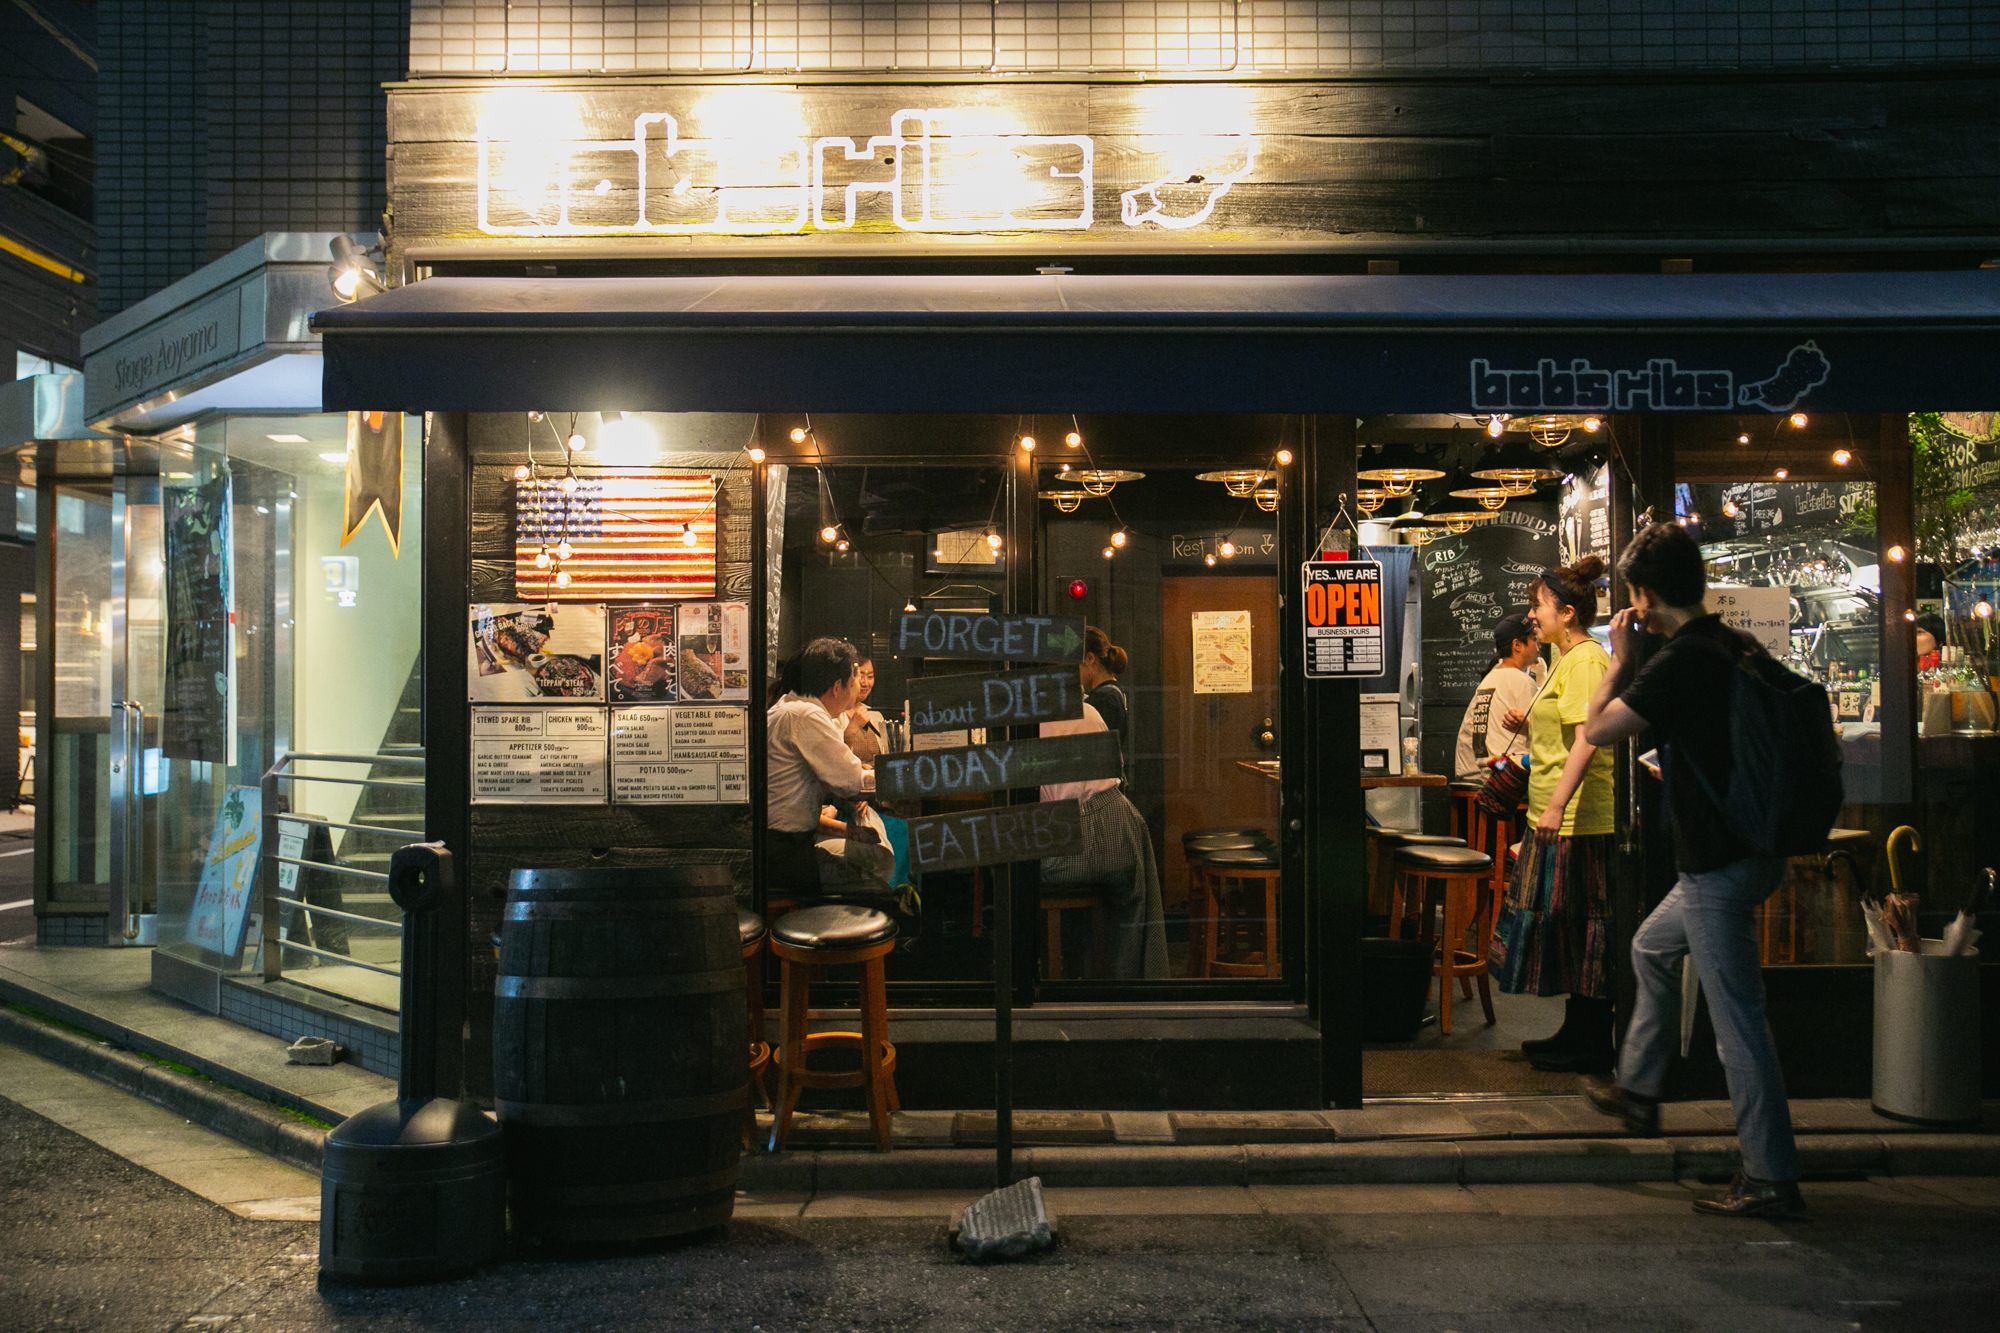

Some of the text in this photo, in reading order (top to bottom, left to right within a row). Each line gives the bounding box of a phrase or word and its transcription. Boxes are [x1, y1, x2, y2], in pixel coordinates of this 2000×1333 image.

[115, 321, 218, 391] Stage Aoyama
[1172, 534, 1205, 558] Rest
[1435, 549, 1456, 562] RIB
[1355, 569, 1378, 580] ARE
[1307, 583, 1380, 626] OPEN
[1717, 595, 1736, 605] 本日
[899, 613, 1052, 656] FORGET
[1317, 627, 1370, 636] BUSINESS HOURS
[914, 672, 1073, 726] about DIET
[476, 716, 531, 724] STEWED SPARE RIB
[548, 715, 593, 723] CHICKEN WINGS
[617, 713, 638, 721] SALAD
[675, 711, 712, 719] VEGETABLE
[509, 743, 542, 751] APPETIZER
[673, 751, 718, 759] HAM&SAUSAGE
[639, 766, 666, 774] POTATO
[886, 746, 1014, 793] TODAY
[915, 805, 1072, 865] EAT RIBS
